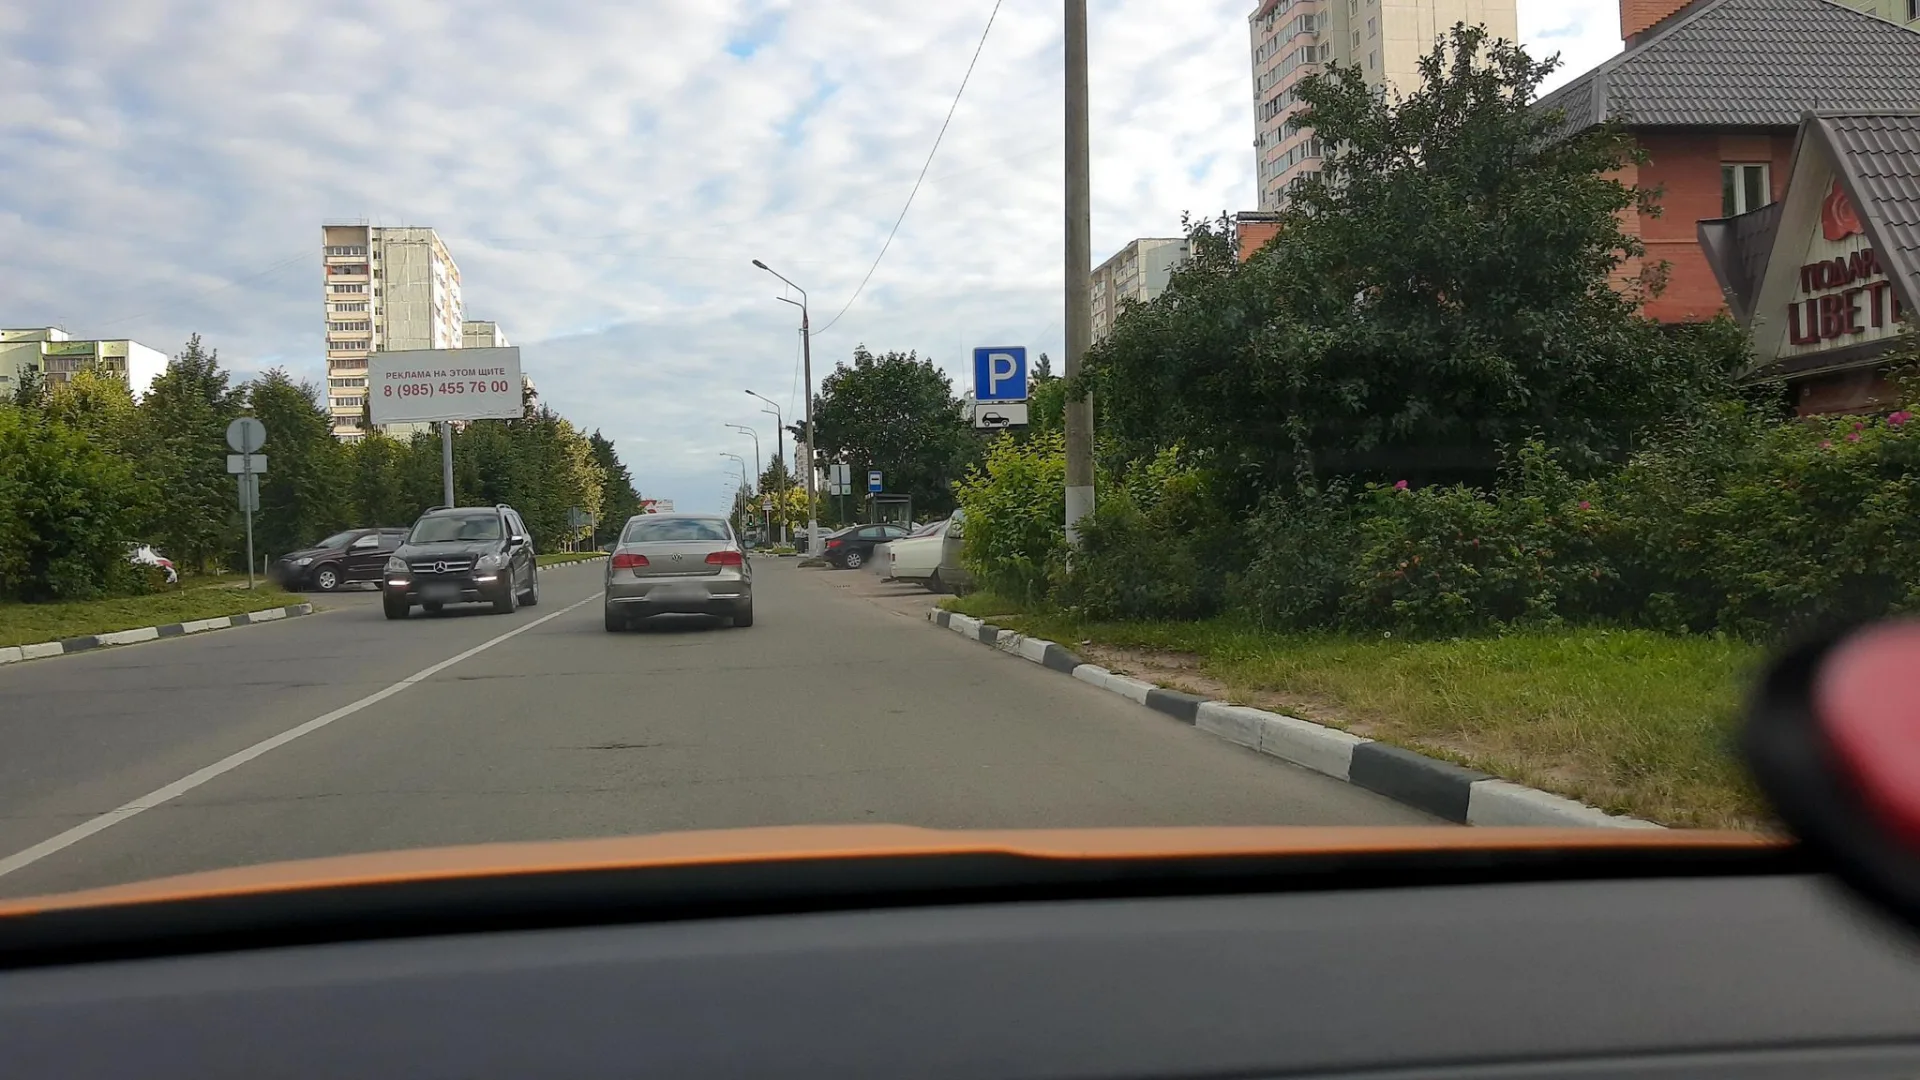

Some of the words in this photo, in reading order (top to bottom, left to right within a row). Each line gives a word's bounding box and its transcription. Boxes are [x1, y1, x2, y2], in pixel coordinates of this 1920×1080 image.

[386, 370, 431, 380] РЕКЛАМА
[478, 368, 505, 376] ЩИТЕ
[988, 353, 1017, 395] P
[384, 385, 392, 397] 8
[397, 382, 434, 399] (985)
[438, 382, 464, 394] 455
[469, 381, 486, 393] 76
[491, 380, 508, 392] 00
